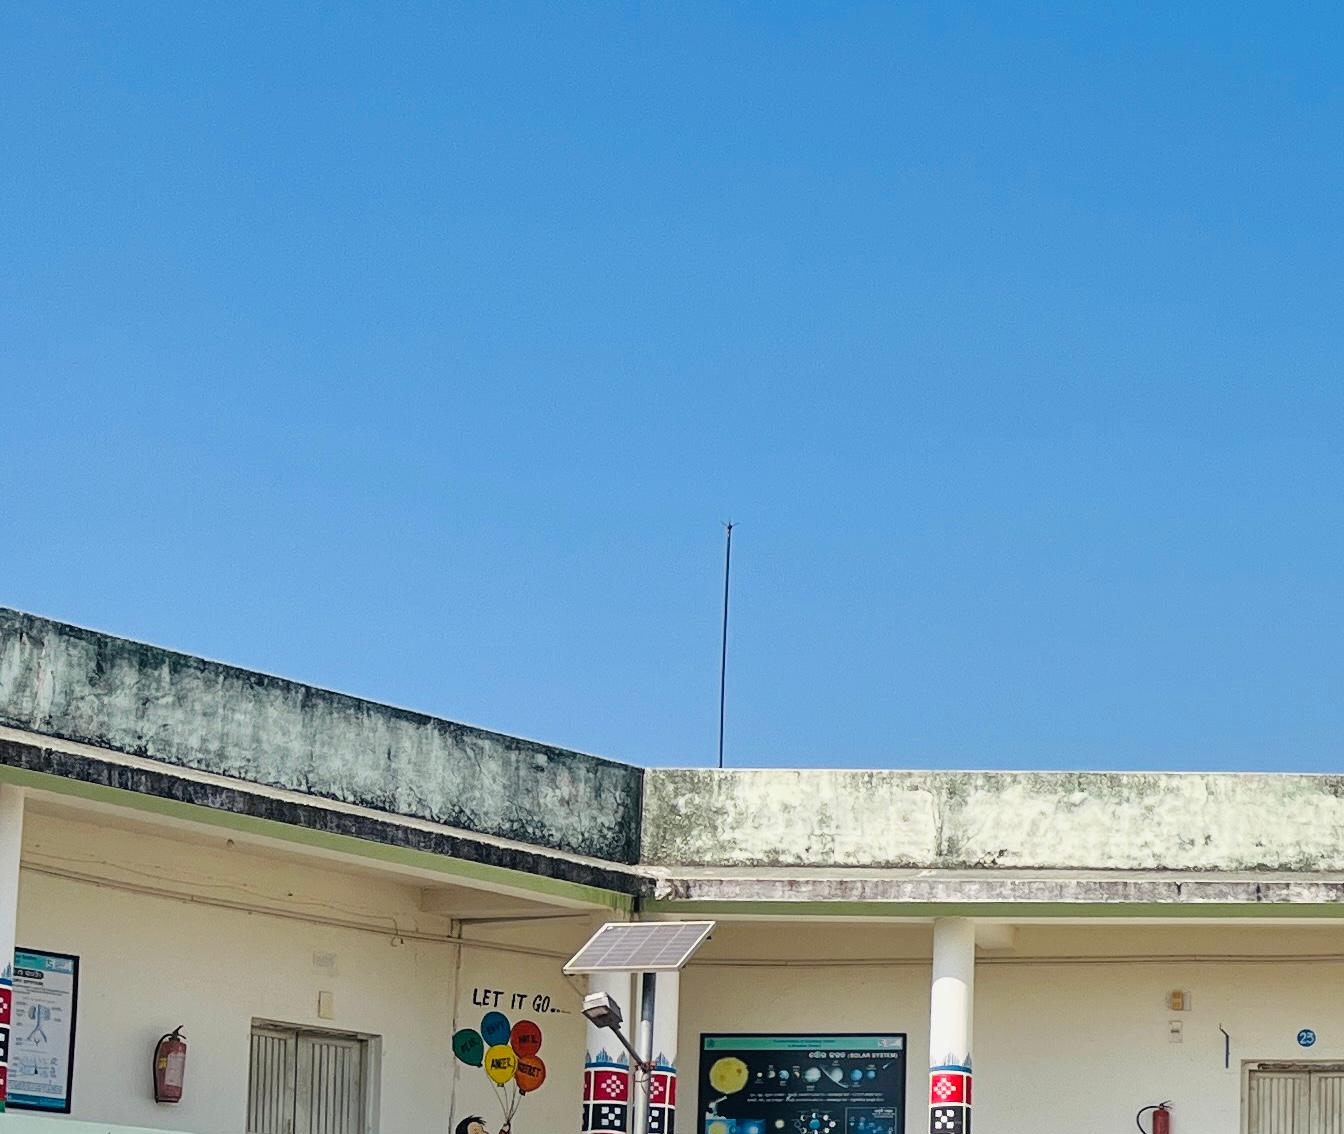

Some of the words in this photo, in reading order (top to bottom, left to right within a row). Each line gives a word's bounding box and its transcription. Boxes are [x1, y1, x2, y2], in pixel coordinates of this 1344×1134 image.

[472, 988, 504, 1007] LET
[511, 993, 527, 1009] IT
[1300, 1031, 1314, 1044] 23
